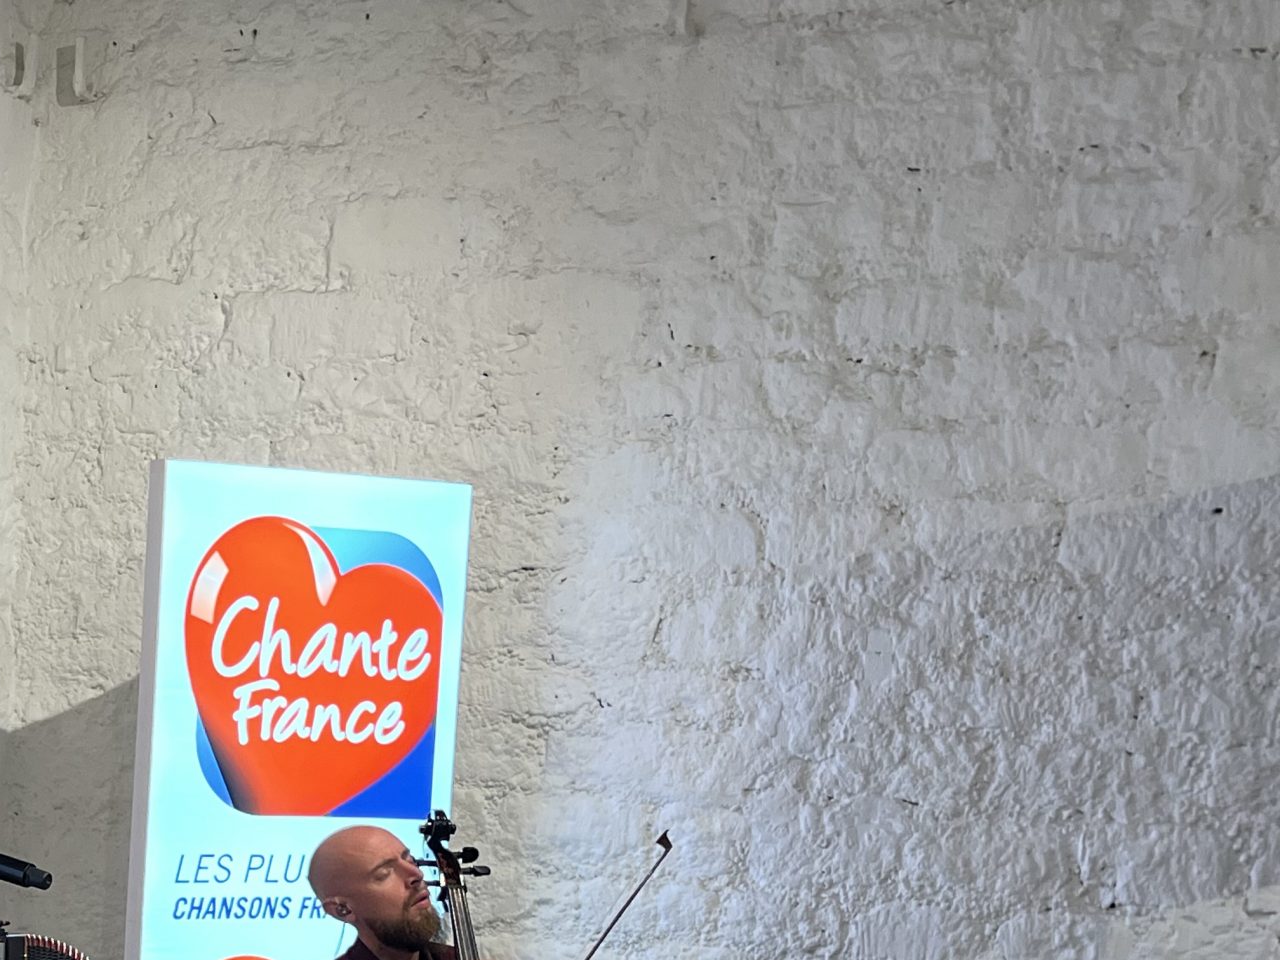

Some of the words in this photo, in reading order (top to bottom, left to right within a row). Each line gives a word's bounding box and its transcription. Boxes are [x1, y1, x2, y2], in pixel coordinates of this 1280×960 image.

[211, 595, 432, 682] Chante
[232, 678, 405, 746] France
[175, 854, 233, 883] LES
[244, 854, 308, 883] PLU
[173, 896, 292, 919] CHANSONS
